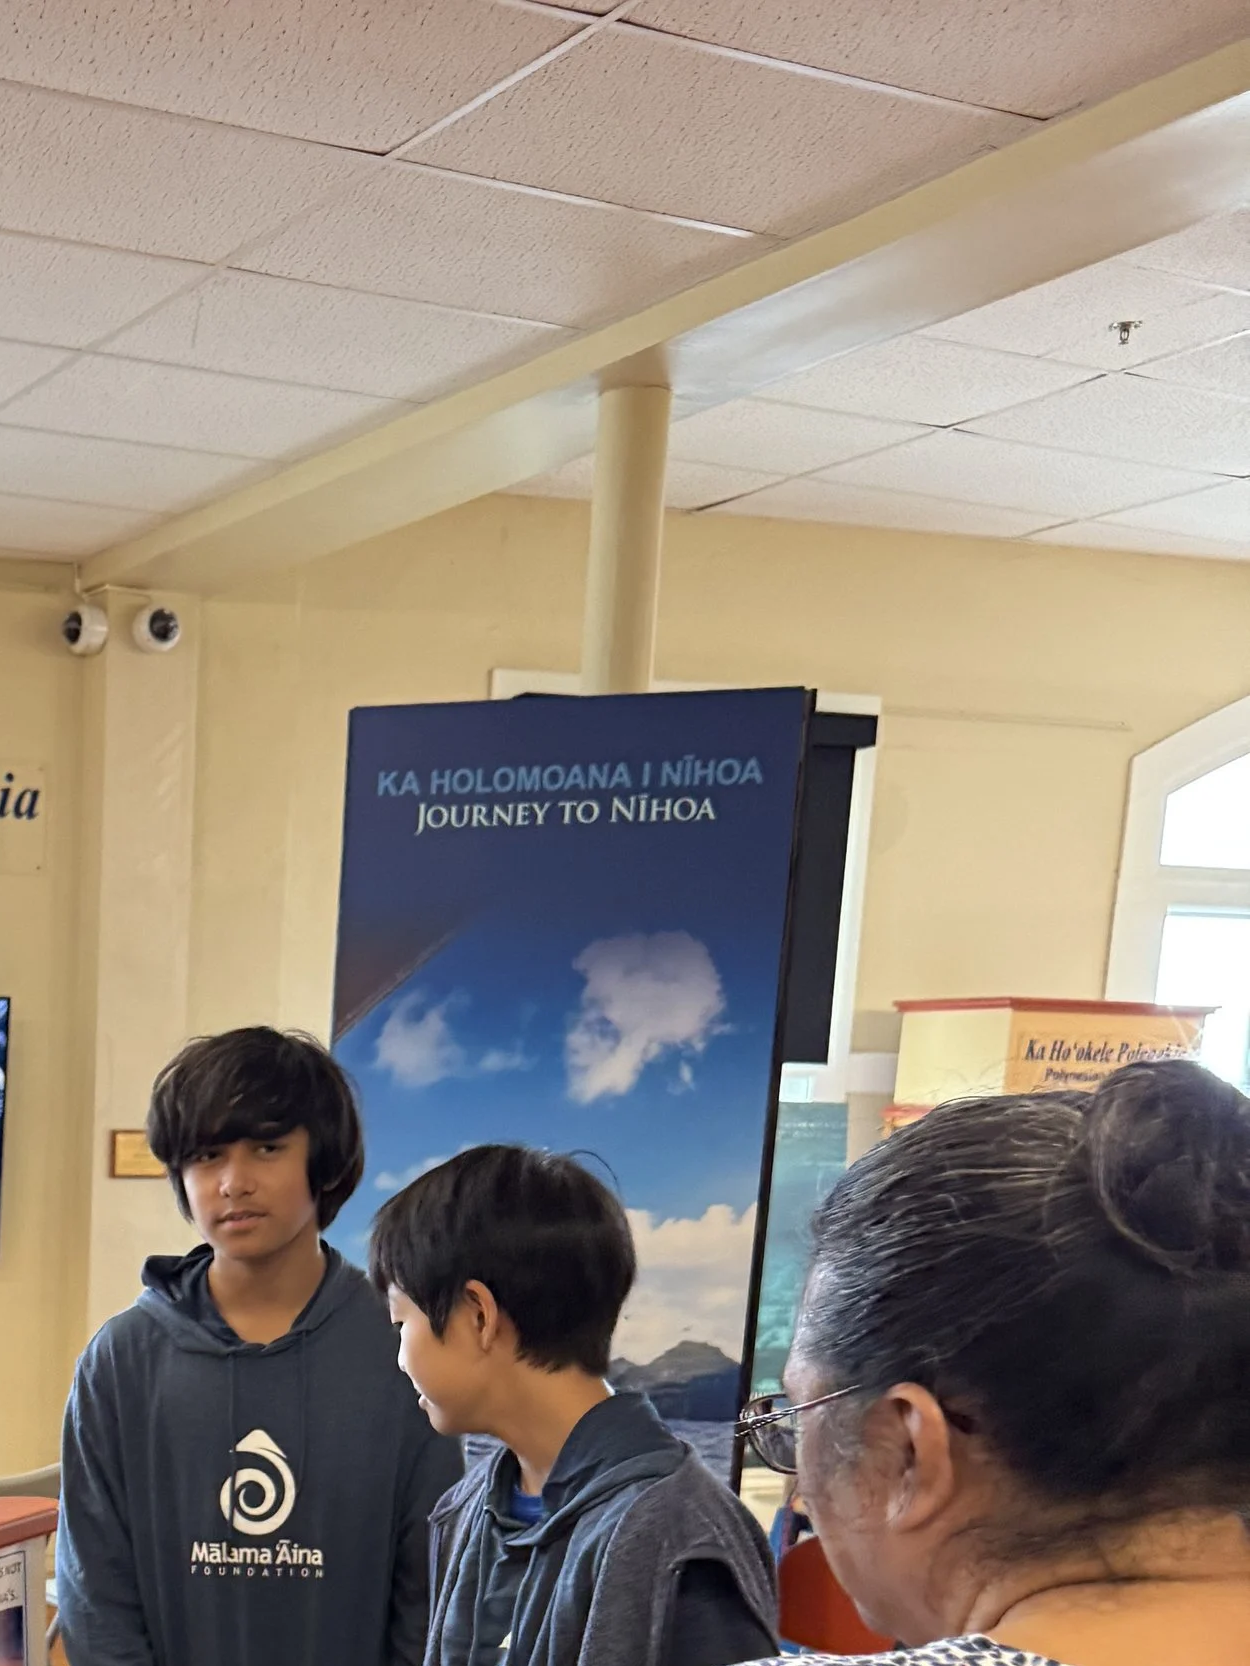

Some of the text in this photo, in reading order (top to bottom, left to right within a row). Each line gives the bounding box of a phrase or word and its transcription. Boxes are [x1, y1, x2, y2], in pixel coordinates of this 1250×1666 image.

[377, 755, 763, 796] KA HOLOMOANA I NĪHOA
[414, 801, 550, 836] JOURNEY
[558, 800, 600, 825] TO
[1025, 1039, 1046, 1061] Ka
[190, 1565, 324, 1579] FOUNDATION
